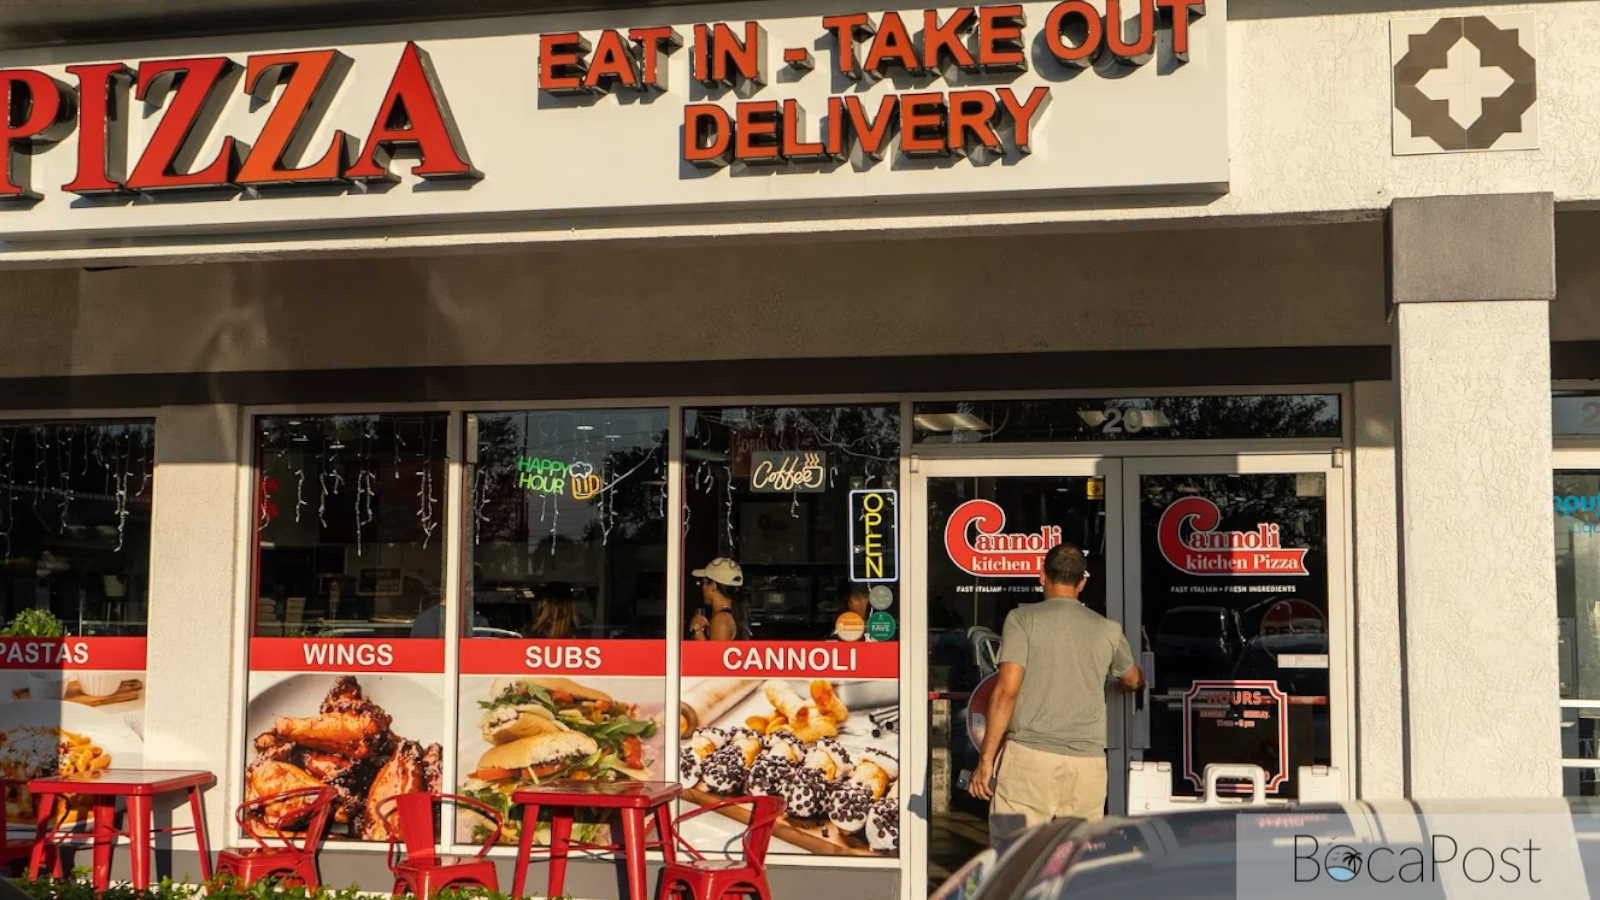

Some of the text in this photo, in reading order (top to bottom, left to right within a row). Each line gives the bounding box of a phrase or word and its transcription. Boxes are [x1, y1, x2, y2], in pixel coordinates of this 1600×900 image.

[538, 26, 673, 91] EAT
[693, 21, 758, 83] IN
[822, 5, 1024, 74] TAKE
[1045, 0, 1204, 62] OUT
[0, 41, 471, 195] PIZZA
[683, 87, 1050, 161] DELIVERY
[1102, 408, 1143, 433] 20
[518, 456, 570, 479] HAPPY
[752, 457, 813, 490] Coffee
[518, 472, 565, 495] HOUR
[864, 493, 884, 578] OPEN
[971, 556, 1031, 572] kitchen
[1186, 554, 1298, 570] kitchen Pizza
[975, 585, 1001, 593] ITALIAN
[1190, 585, 1218, 593] ITALIAN
[1224, 585, 1247, 593] FRESH
[1248, 584, 1296, 593] INGREDIENTS
[303, 643, 393, 666] WINGS
[525, 646, 601, 669] SUBS
[723, 647, 857, 671] CANNOLI
